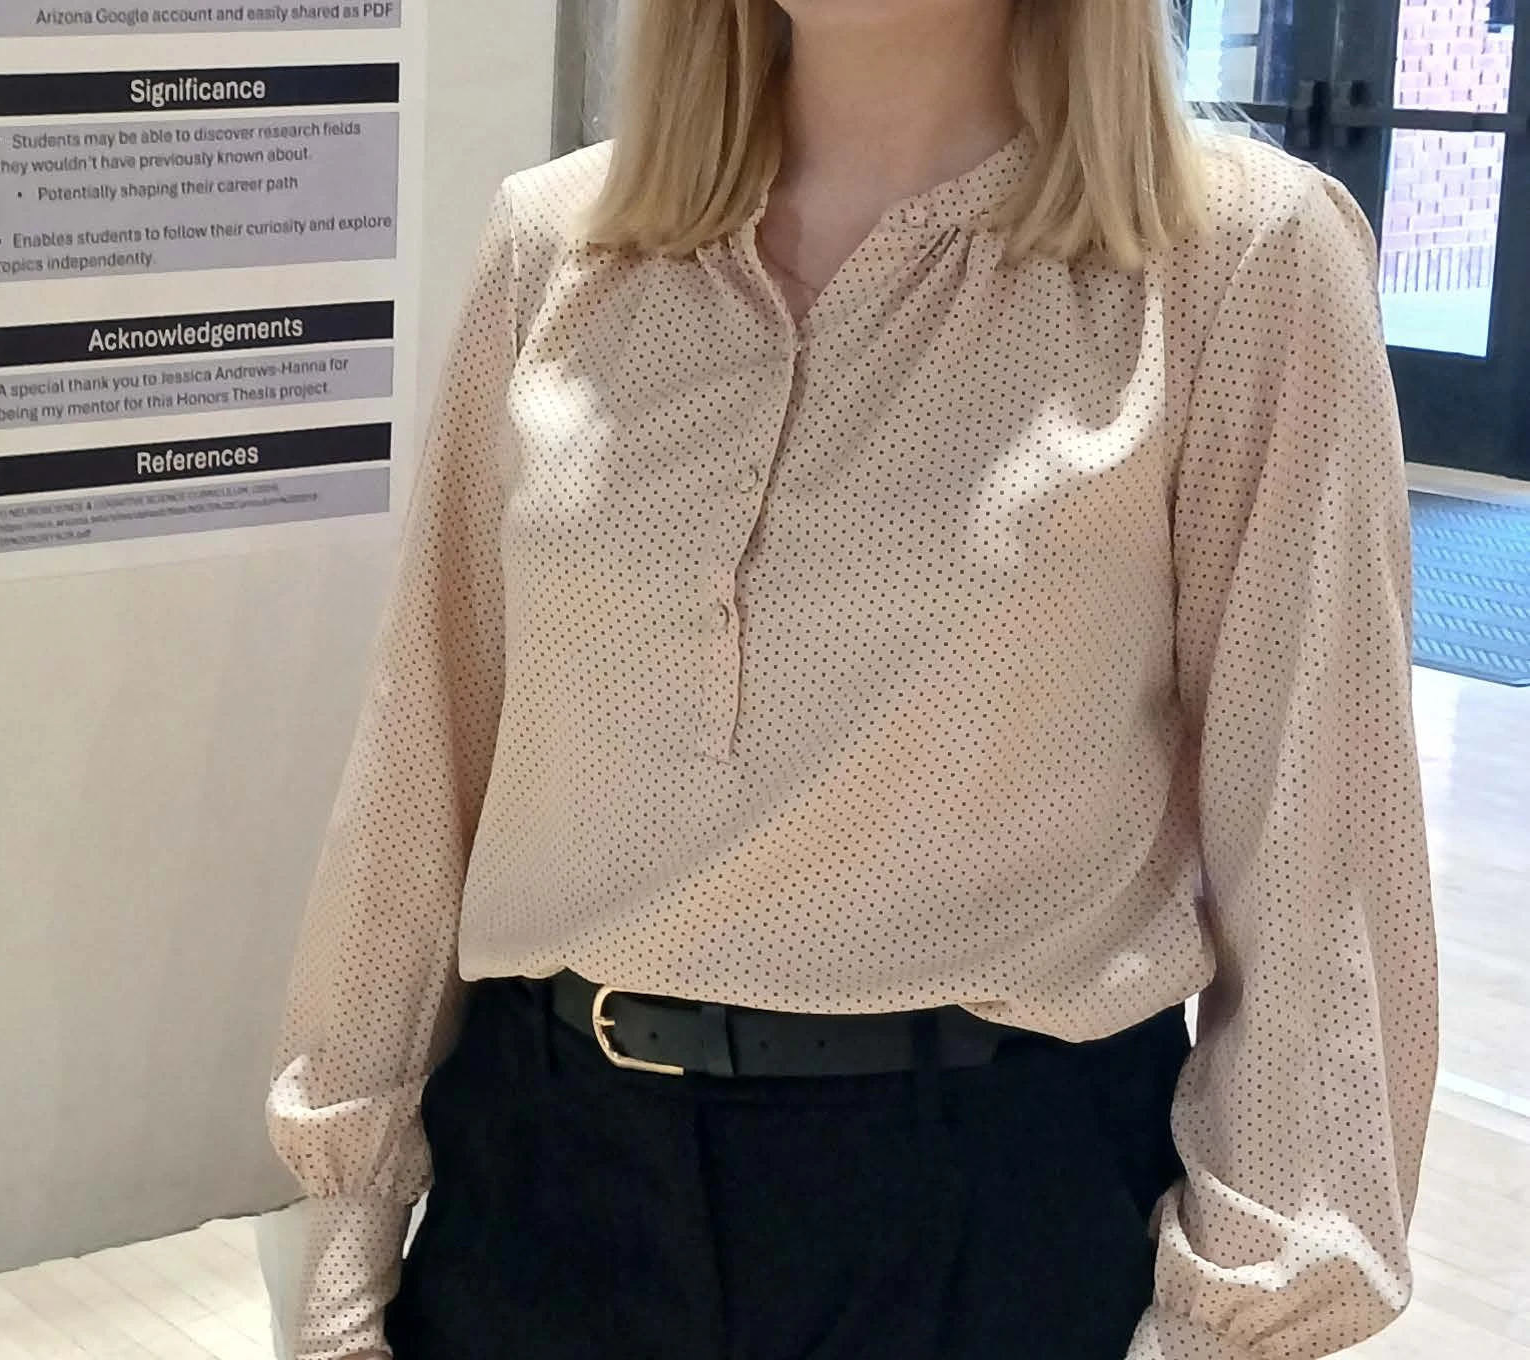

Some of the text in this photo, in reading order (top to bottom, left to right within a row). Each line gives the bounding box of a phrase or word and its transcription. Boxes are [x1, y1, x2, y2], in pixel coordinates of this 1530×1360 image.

[130, 77, 266, 106] Significance
[11, 120, 361, 149] Students may be able to discover research fields
[30, 154, 97, 173] wouldn't
[100, 154, 136, 169] have
[138, 151, 214, 170] previously
[216, 149, 264, 164] known
[37, 175, 298, 201] Potentially shaping their career path
[12, 215, 392, 248] Enables students to follow their curiosity and explore
[87, 318, 303, 351] Acknowledgements
[9, 378, 65, 399] special
[67, 375, 109, 392] thank
[111, 375, 139, 392] you
[141, 372, 157, 387] to
[160, 368, 212, 384] Jessica
[328, 356, 349, 371] for
[40, 403, 64, 419] my
[66, 399, 121, 416] mentor
[122, 395, 143, 411] for
[146, 391, 173, 408] this
[176, 391, 229, 406] Honors
[231, 385, 277, 401] Thesis
[136, 446, 259, 473] References
